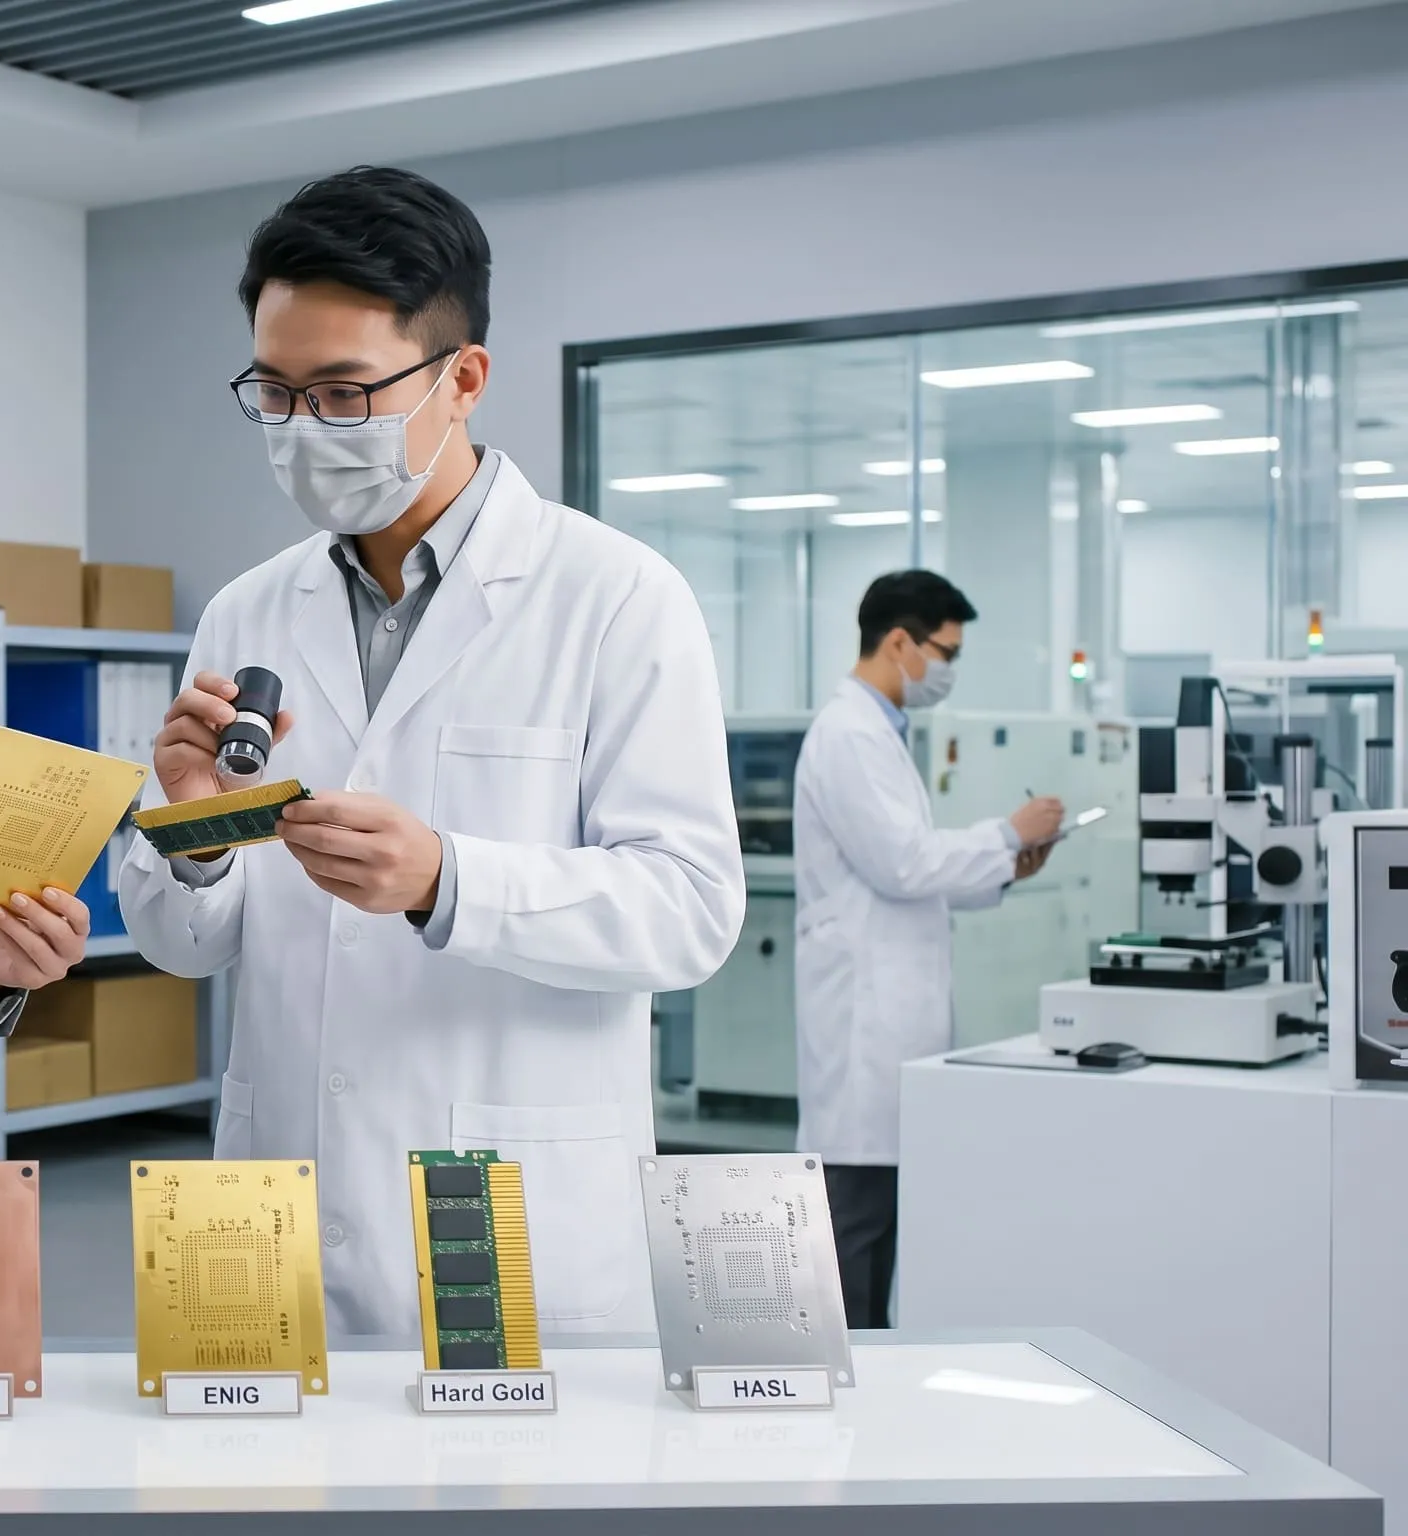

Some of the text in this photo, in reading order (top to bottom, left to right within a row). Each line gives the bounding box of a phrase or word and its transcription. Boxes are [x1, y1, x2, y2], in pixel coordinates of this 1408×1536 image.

[204, 1386, 259, 1405] ENIG
[431, 1383, 545, 1402] Hard Gold
[733, 1379, 797, 1398] HASL
